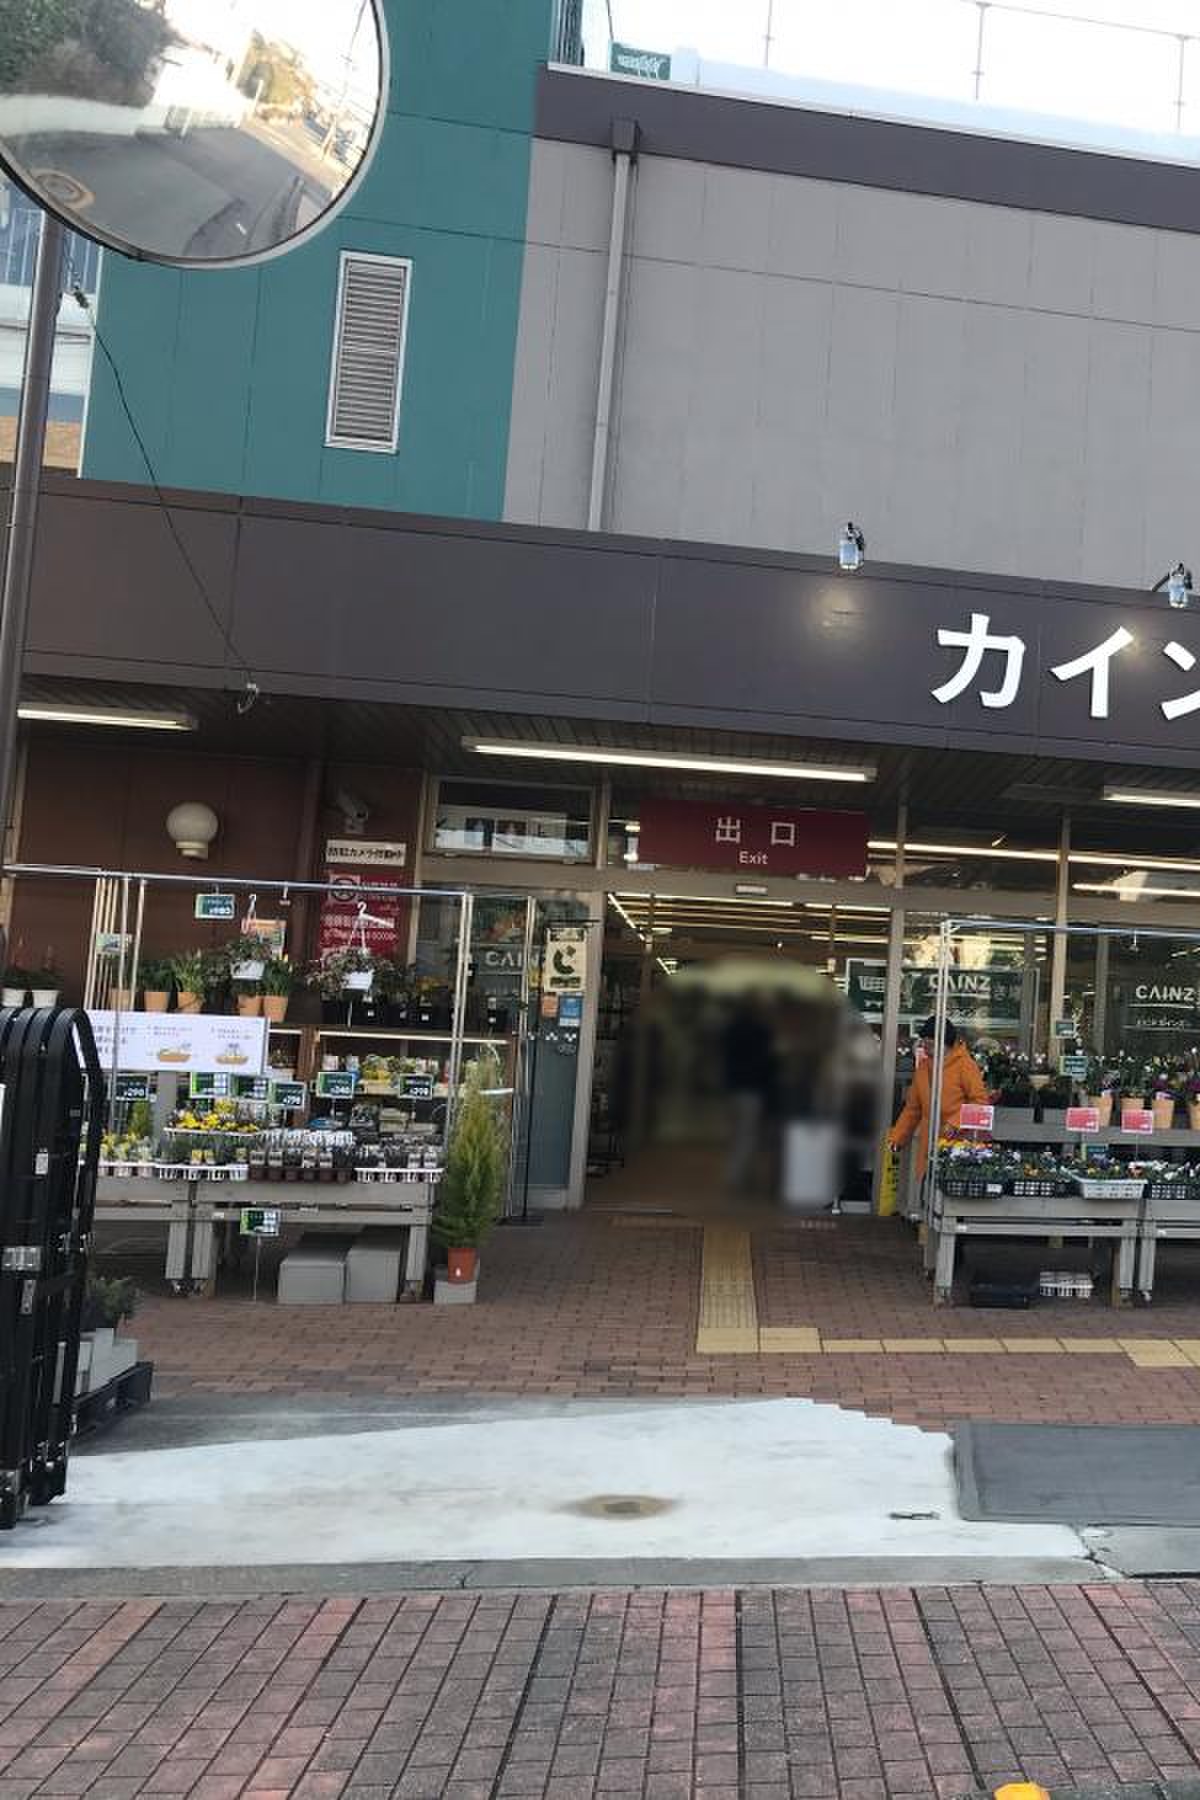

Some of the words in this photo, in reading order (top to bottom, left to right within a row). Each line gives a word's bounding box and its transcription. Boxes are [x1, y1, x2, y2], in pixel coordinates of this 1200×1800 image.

[715, 816, 796, 847] 出口
[738, 850, 769, 865] Exit
[1135, 984, 1195, 1002] CAINZ
